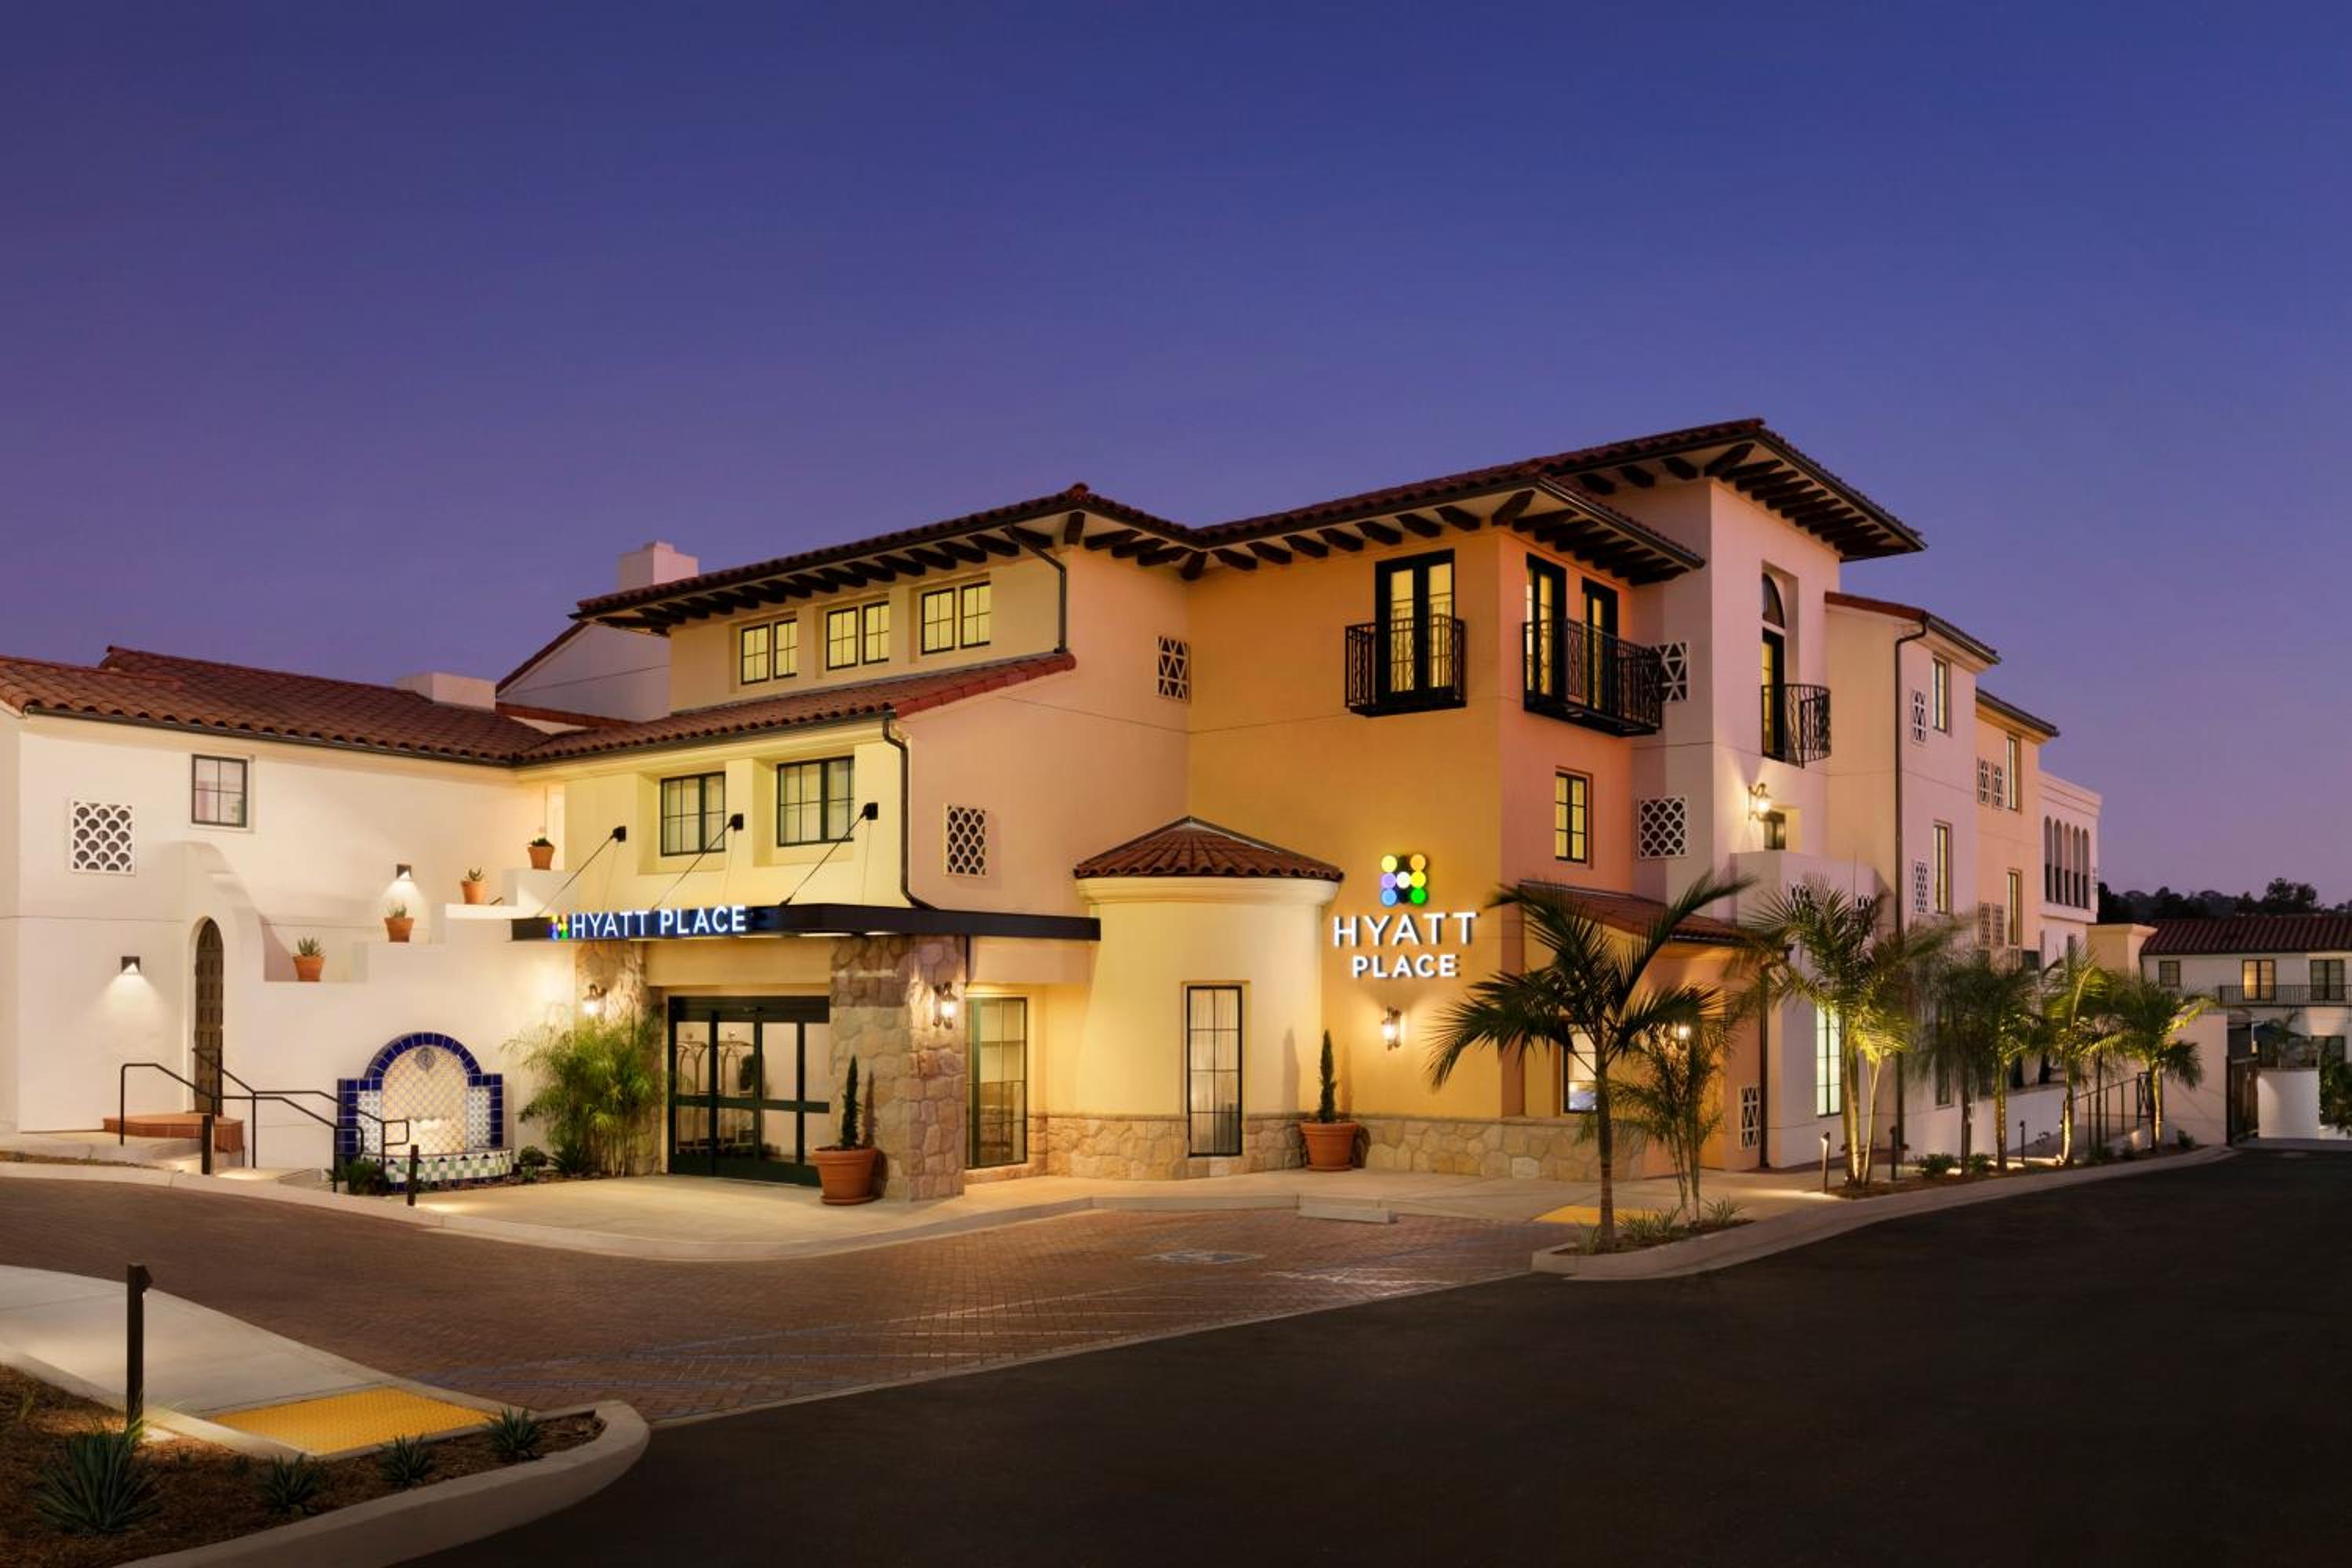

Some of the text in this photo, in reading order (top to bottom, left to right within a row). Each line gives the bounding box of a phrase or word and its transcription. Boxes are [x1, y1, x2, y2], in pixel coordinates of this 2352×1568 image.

[572, 906, 746, 938] HYATT PLACE
[1334, 912, 1477, 947] HYATT
[1352, 954, 1456, 978] PLACE
